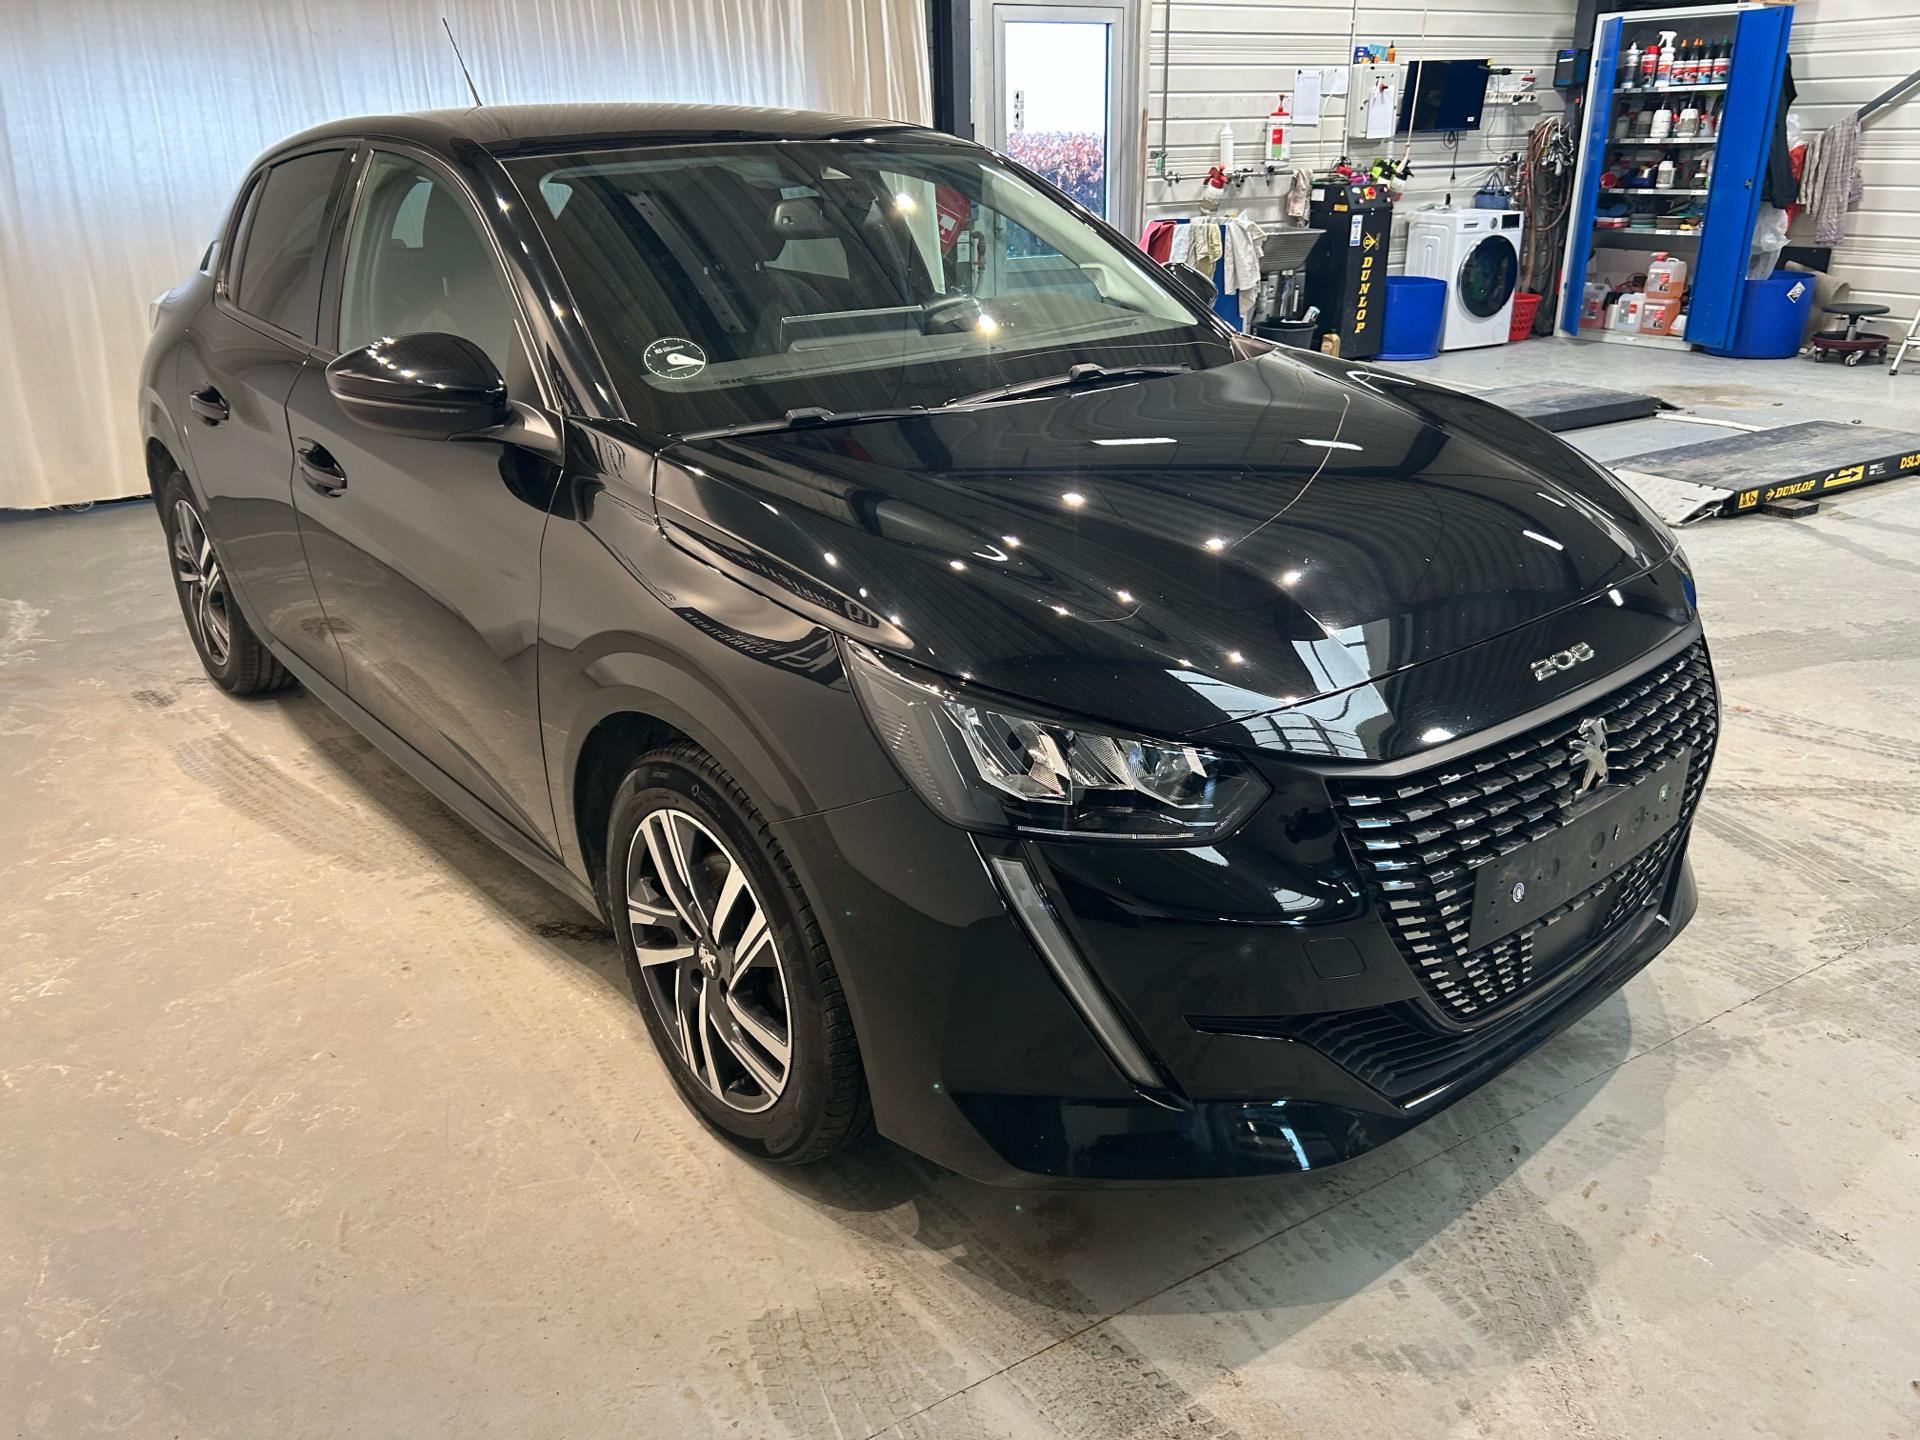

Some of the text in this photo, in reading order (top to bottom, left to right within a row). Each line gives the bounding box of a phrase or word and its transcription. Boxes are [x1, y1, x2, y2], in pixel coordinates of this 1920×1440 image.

[1354, 256, 1373, 334] DUNLOP
[1774, 480, 1816, 499] DUNLOP
[1530, 641, 1595, 682] 208
